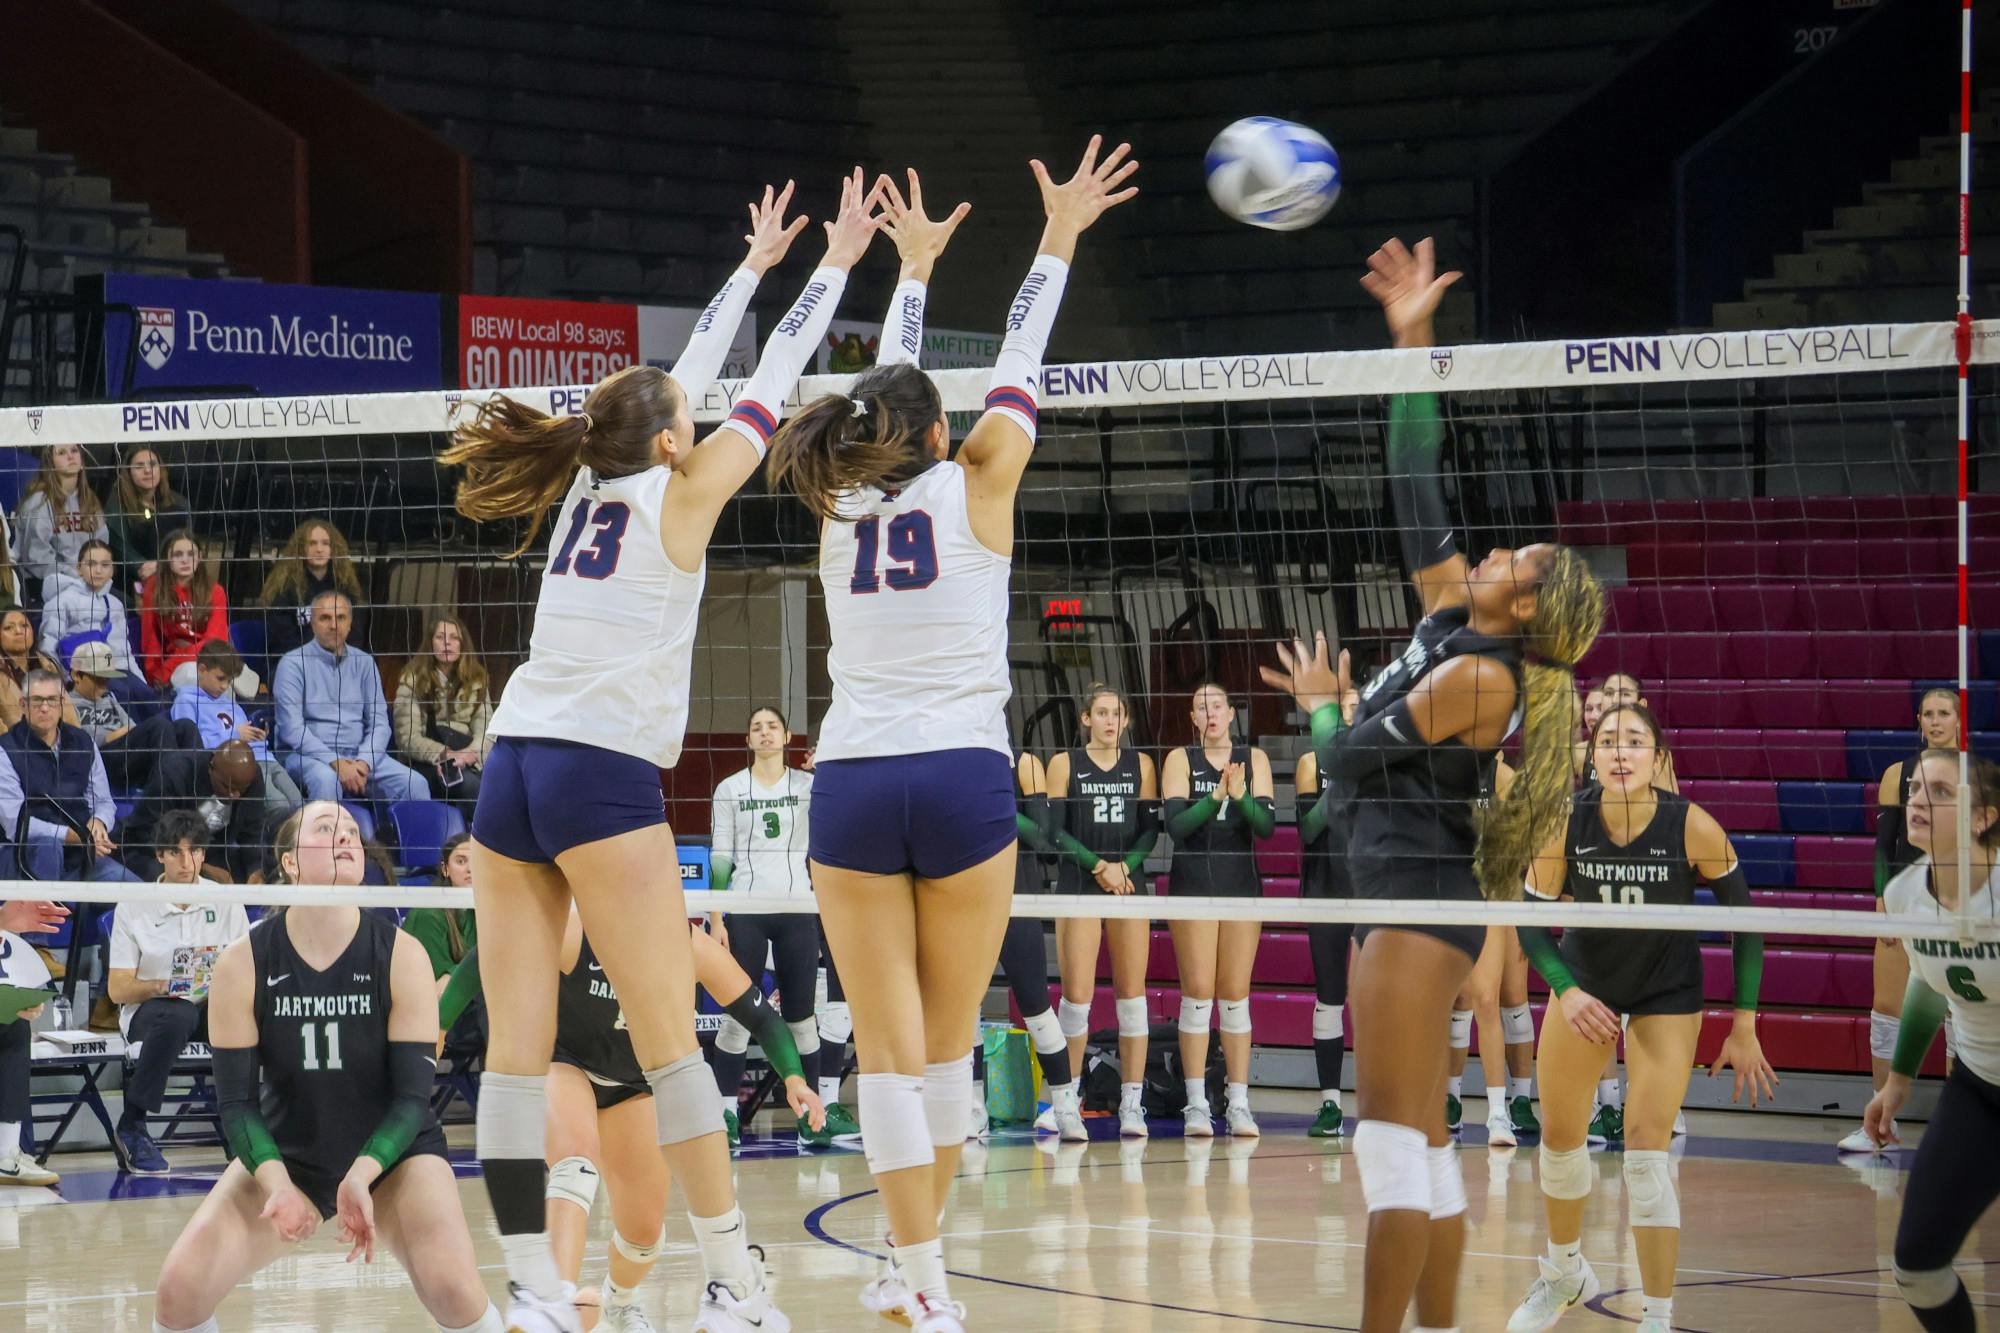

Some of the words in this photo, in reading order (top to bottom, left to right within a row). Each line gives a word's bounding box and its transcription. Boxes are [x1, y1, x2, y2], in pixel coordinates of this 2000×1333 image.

[1793, 27, 1838, 53] 207
[777, 282, 828, 337] QUAKERS
[1006, 272, 1048, 332] QUAKERS
[186, 310, 264, 354] Penn
[269, 315, 414, 362] Medicine
[471, 316, 515, 340] IBEW
[518, 320, 560, 342] Local
[564, 322, 584, 344] 98
[588, 328, 625, 351] says:
[901, 295, 922, 355] QUAKERS
[466, 345, 500, 389] GO
[1565, 342, 1661, 374] PENN
[1668, 327, 1909, 370] VOLLEYBALL
[1038, 365, 1108, 396] ENN
[1117, 356, 1324, 392] VOLLEYBALL
[123, 405, 190, 432] PENN
[196, 399, 361, 429] VOLLEYBALL
[549, 496, 631, 580] 13
[850, 508, 939, 595] 19
[739, 795, 799, 812] DARTMOUTH
[1081, 782, 1134, 795] DARTMOUTH
[762, 811, 780, 839] 3
[1093, 795, 1125, 823] 22
[1576, 861, 1669, 882] DARTMOUTH
[206, 910, 216, 923] D
[1945, 965, 1986, 1003] 6
[274, 994, 371, 1016] DARTMOUTH
[71, 1040, 107, 1055] PENN
[301, 1021, 343, 1070] 11
